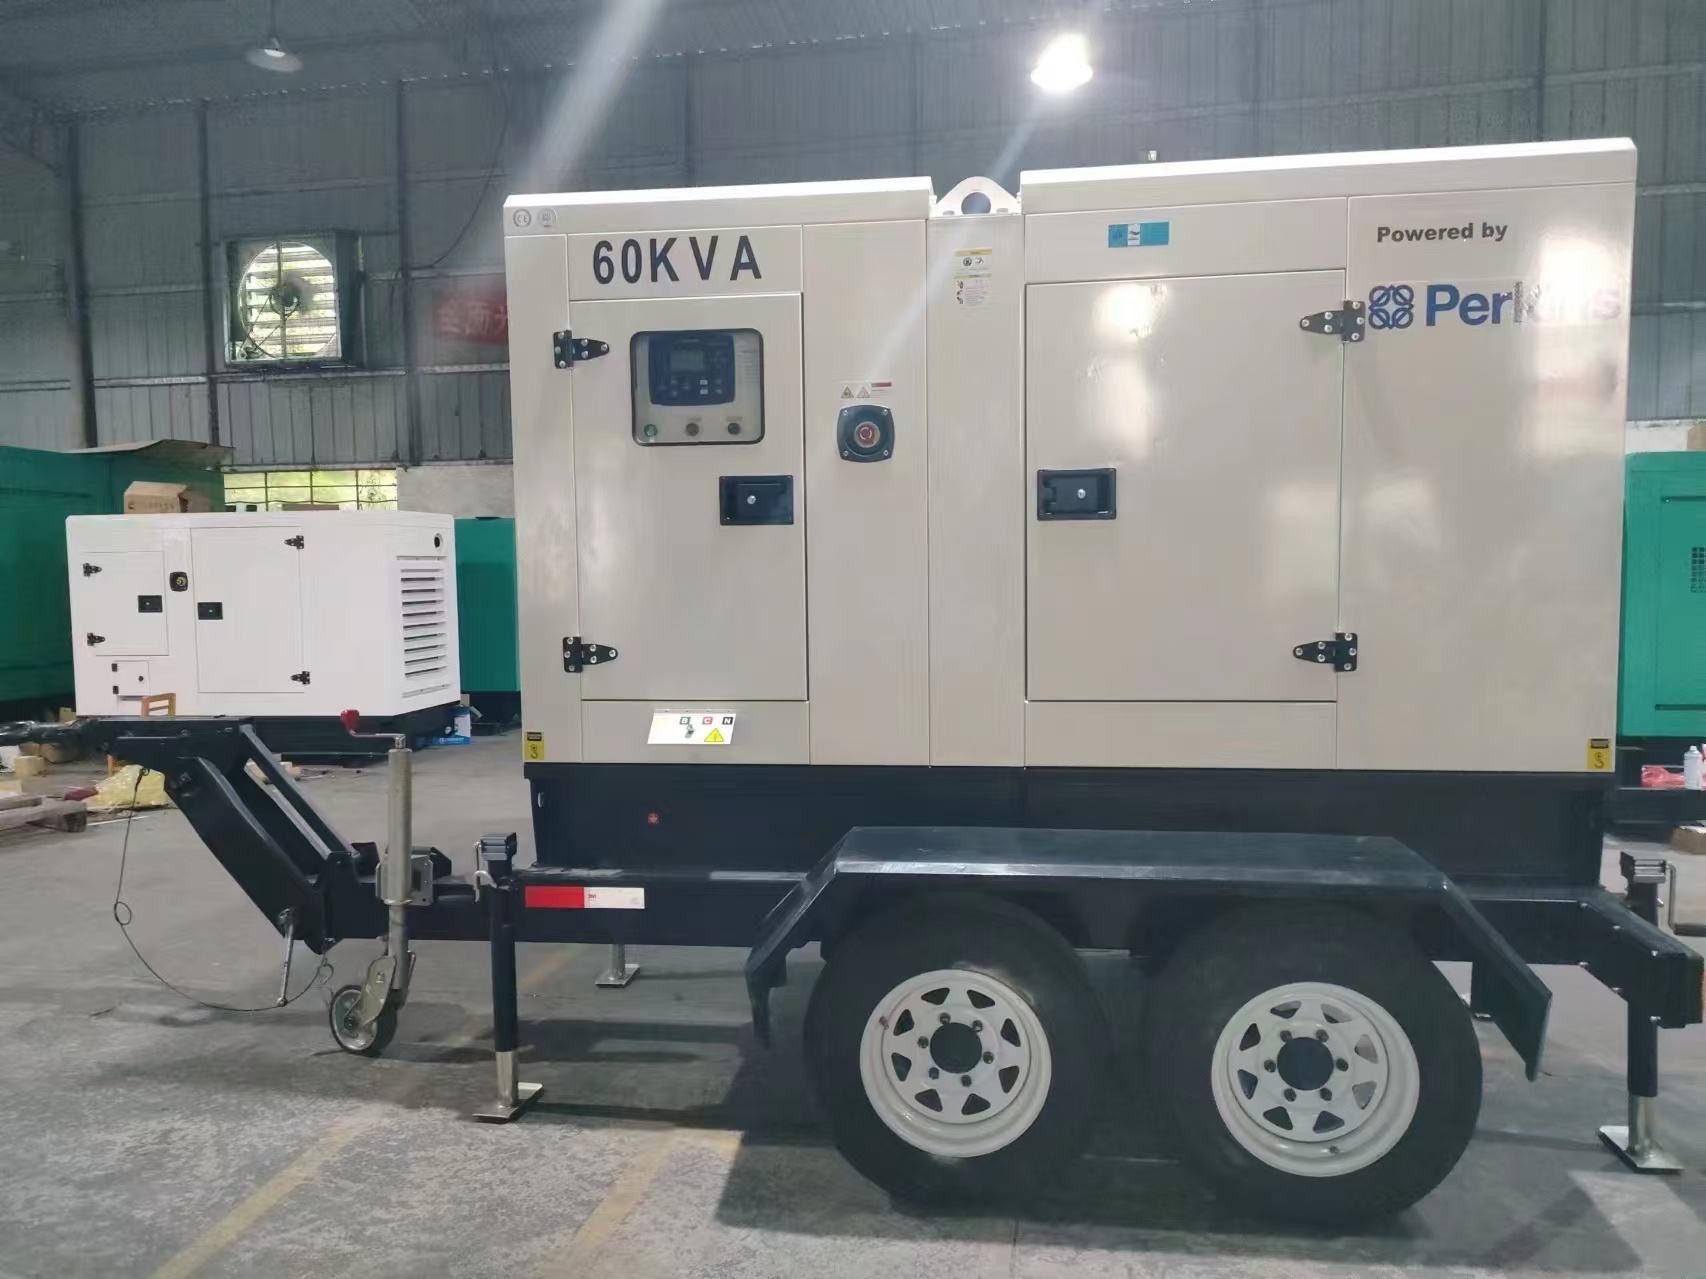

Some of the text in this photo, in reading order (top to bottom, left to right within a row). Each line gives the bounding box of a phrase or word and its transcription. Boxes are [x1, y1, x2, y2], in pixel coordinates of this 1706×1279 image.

[1377, 221, 1508, 243] Powered by
[593, 235, 762, 285] 60KVA
[1425, 280, 1621, 328] Perks
